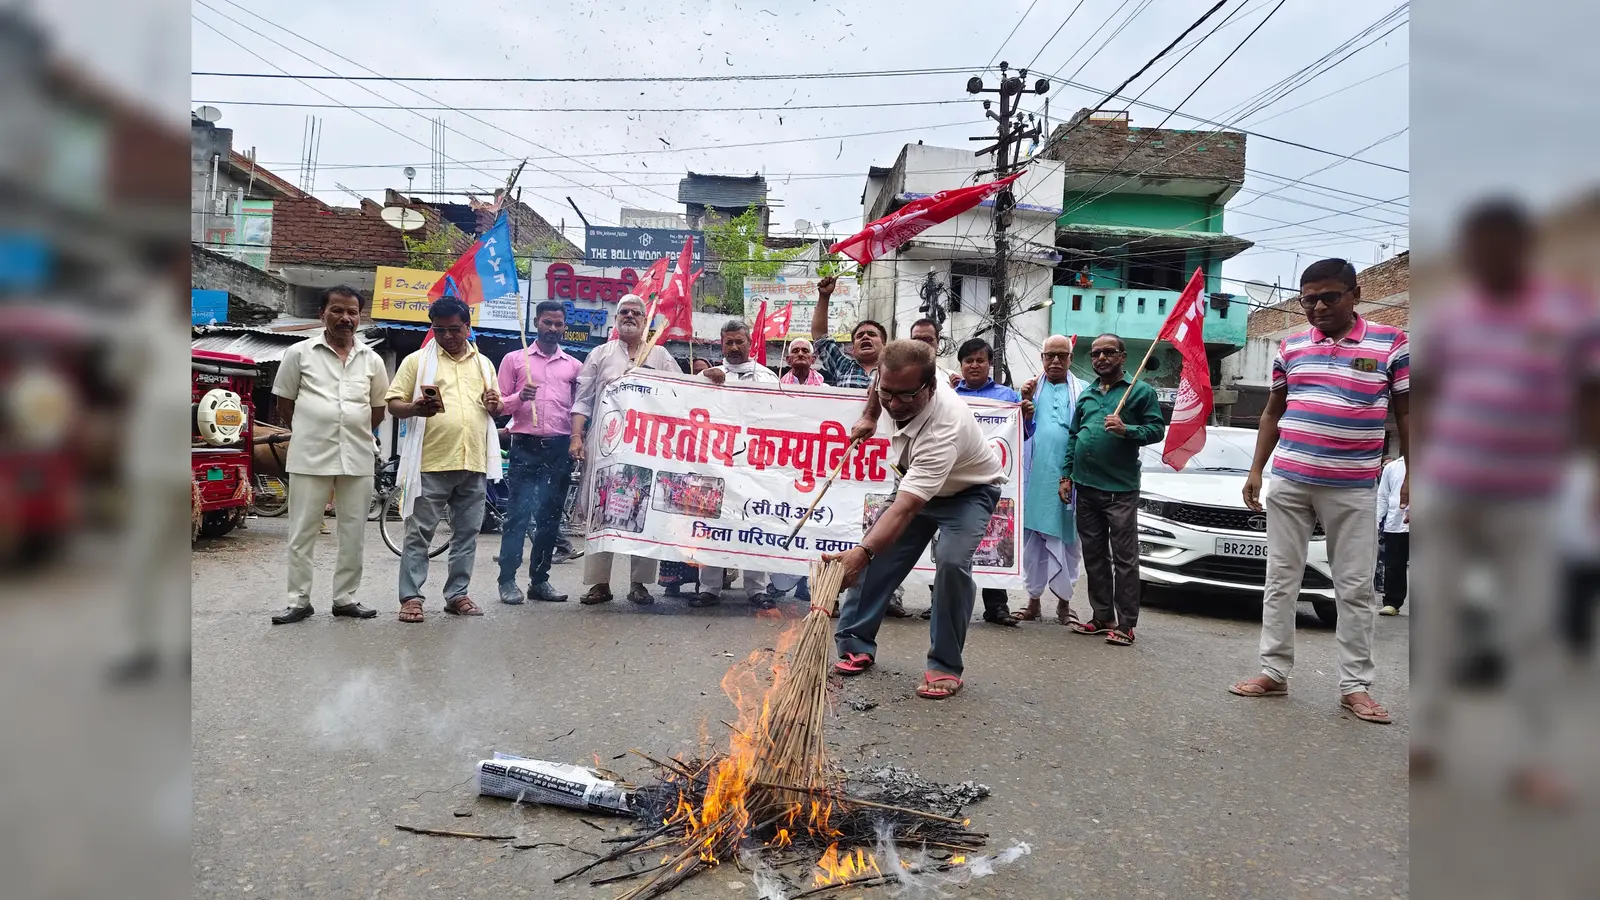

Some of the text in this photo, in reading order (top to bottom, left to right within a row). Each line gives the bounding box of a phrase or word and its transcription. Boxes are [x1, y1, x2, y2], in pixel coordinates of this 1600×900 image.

[484, 237, 506, 286] AIYF
[590, 248, 701, 260] THE BOLLYWOOD FASON
[395, 279, 431, 290] Dr Lal
[198, 374, 230, 384] SPORTS
[623, 408, 891, 493] भारतीय कम्युनिस्ट
[691, 521, 733, 542] जिला
